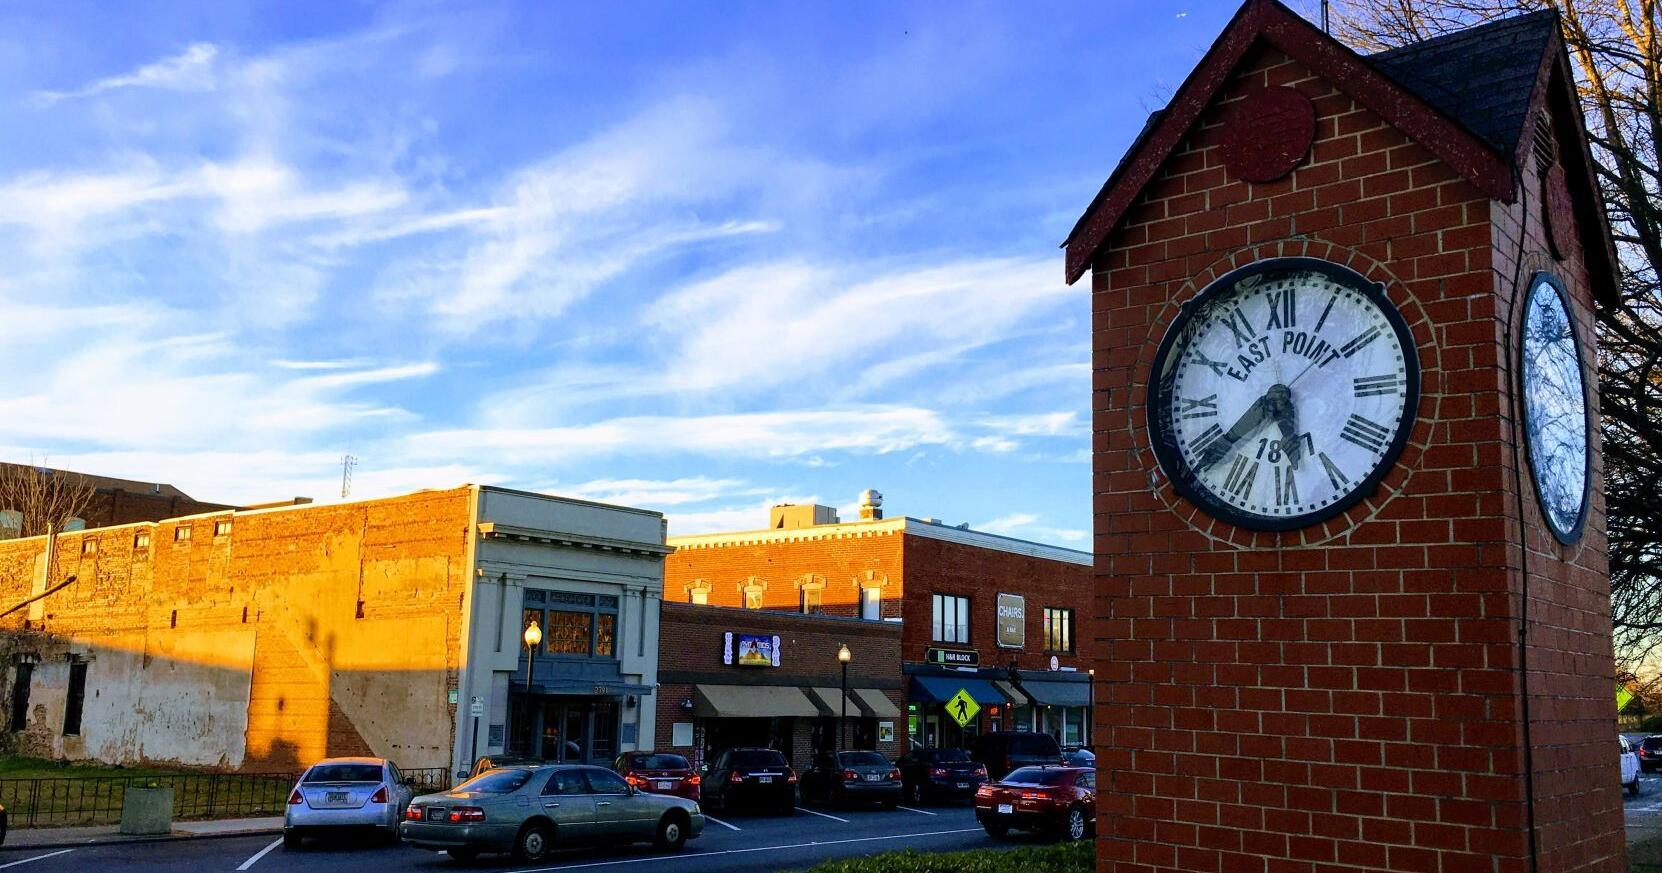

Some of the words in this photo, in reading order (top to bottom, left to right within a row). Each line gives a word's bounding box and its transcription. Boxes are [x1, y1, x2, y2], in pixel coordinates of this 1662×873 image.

[1266, 288, 1296, 331] XII
[1227, 336, 1270, 382] EAST
[1282, 330, 1341, 369] POINT
[1256, 431, 1315, 464] 187
[945, 653, 956, 661] H&R
[956, 654, 971, 662] BLOCK
